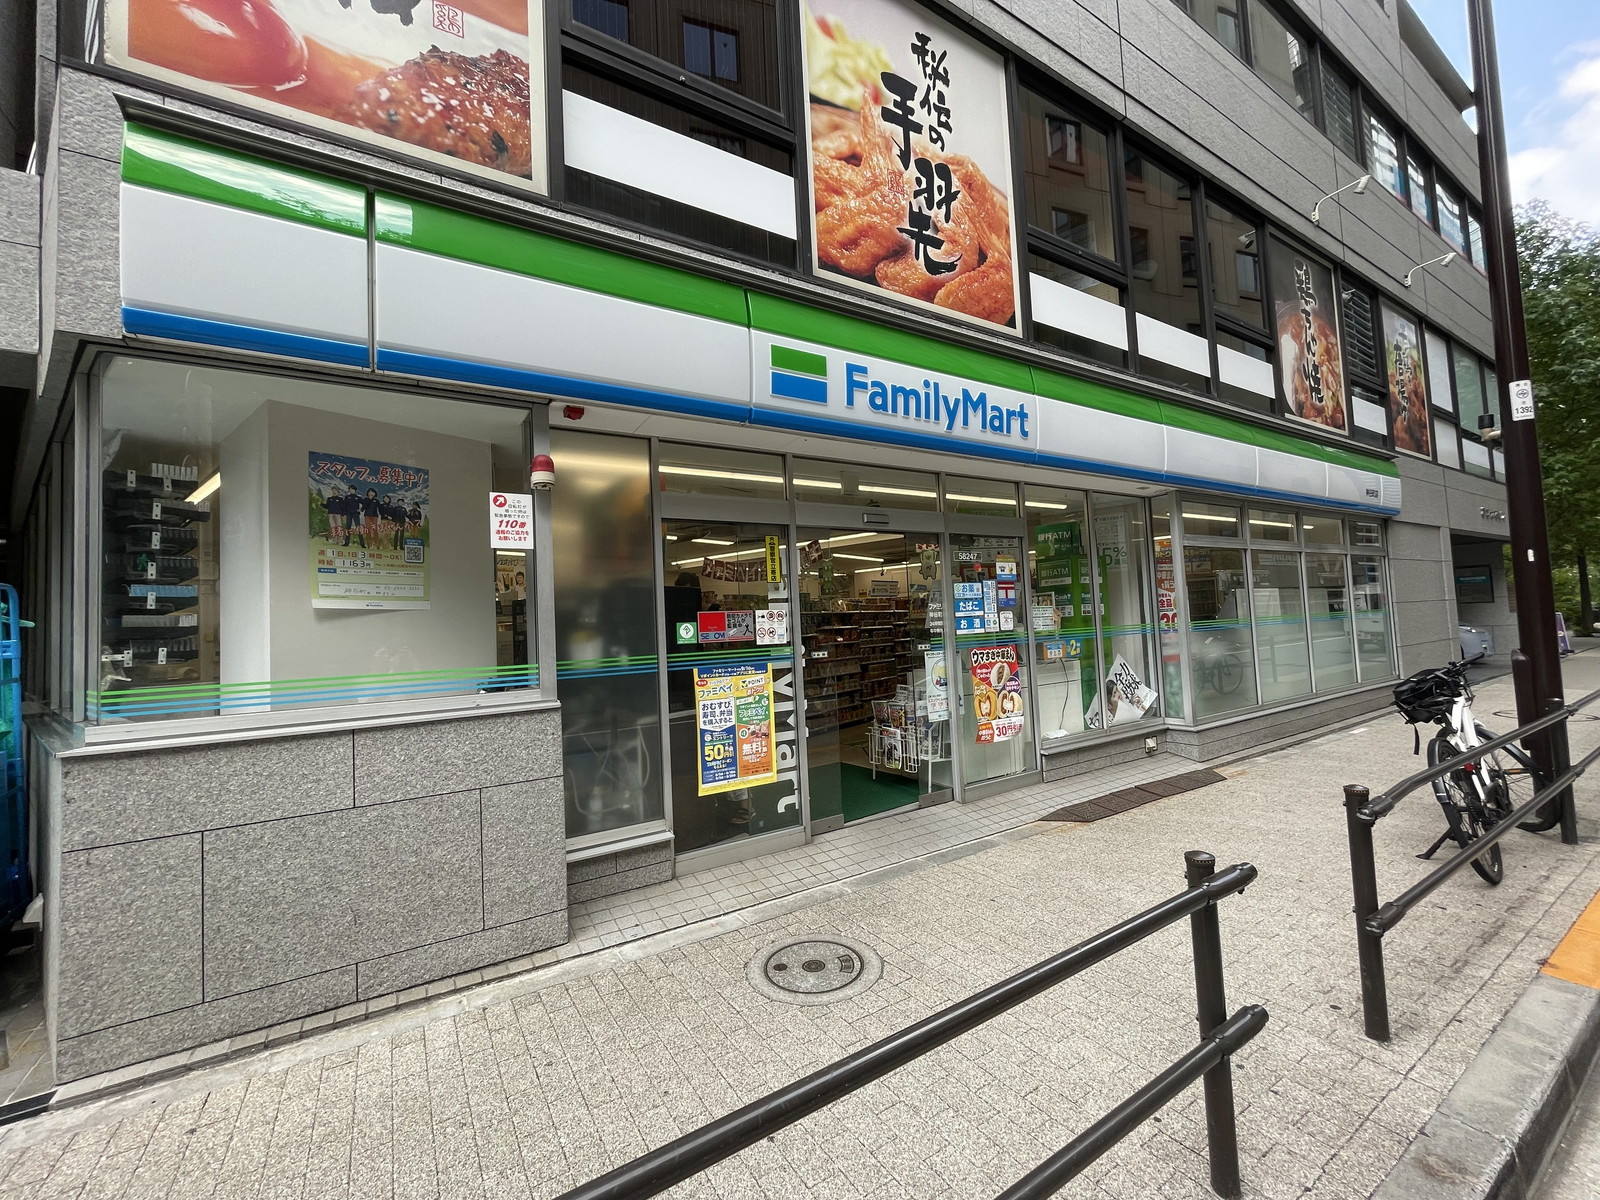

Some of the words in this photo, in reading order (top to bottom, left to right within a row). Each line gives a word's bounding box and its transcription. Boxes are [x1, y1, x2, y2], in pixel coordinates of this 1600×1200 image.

[911, 31, 953, 153] 秘伝の
[880, 71, 963, 275] 手羽先
[844, 362, 1029, 438] FamilyMart
[1515, 405, 1533, 415] 1392
[498, 519, 527, 529] 110番
[958, 552, 978, 560] 58247
[959, 601, 980, 611] たばこ
[960, 618, 981, 629] お酒
[698, 684, 734, 699] ファミペイ
[702, 710, 733, 719] 寿司、弁当
[703, 718, 733, 726] を購入すると
